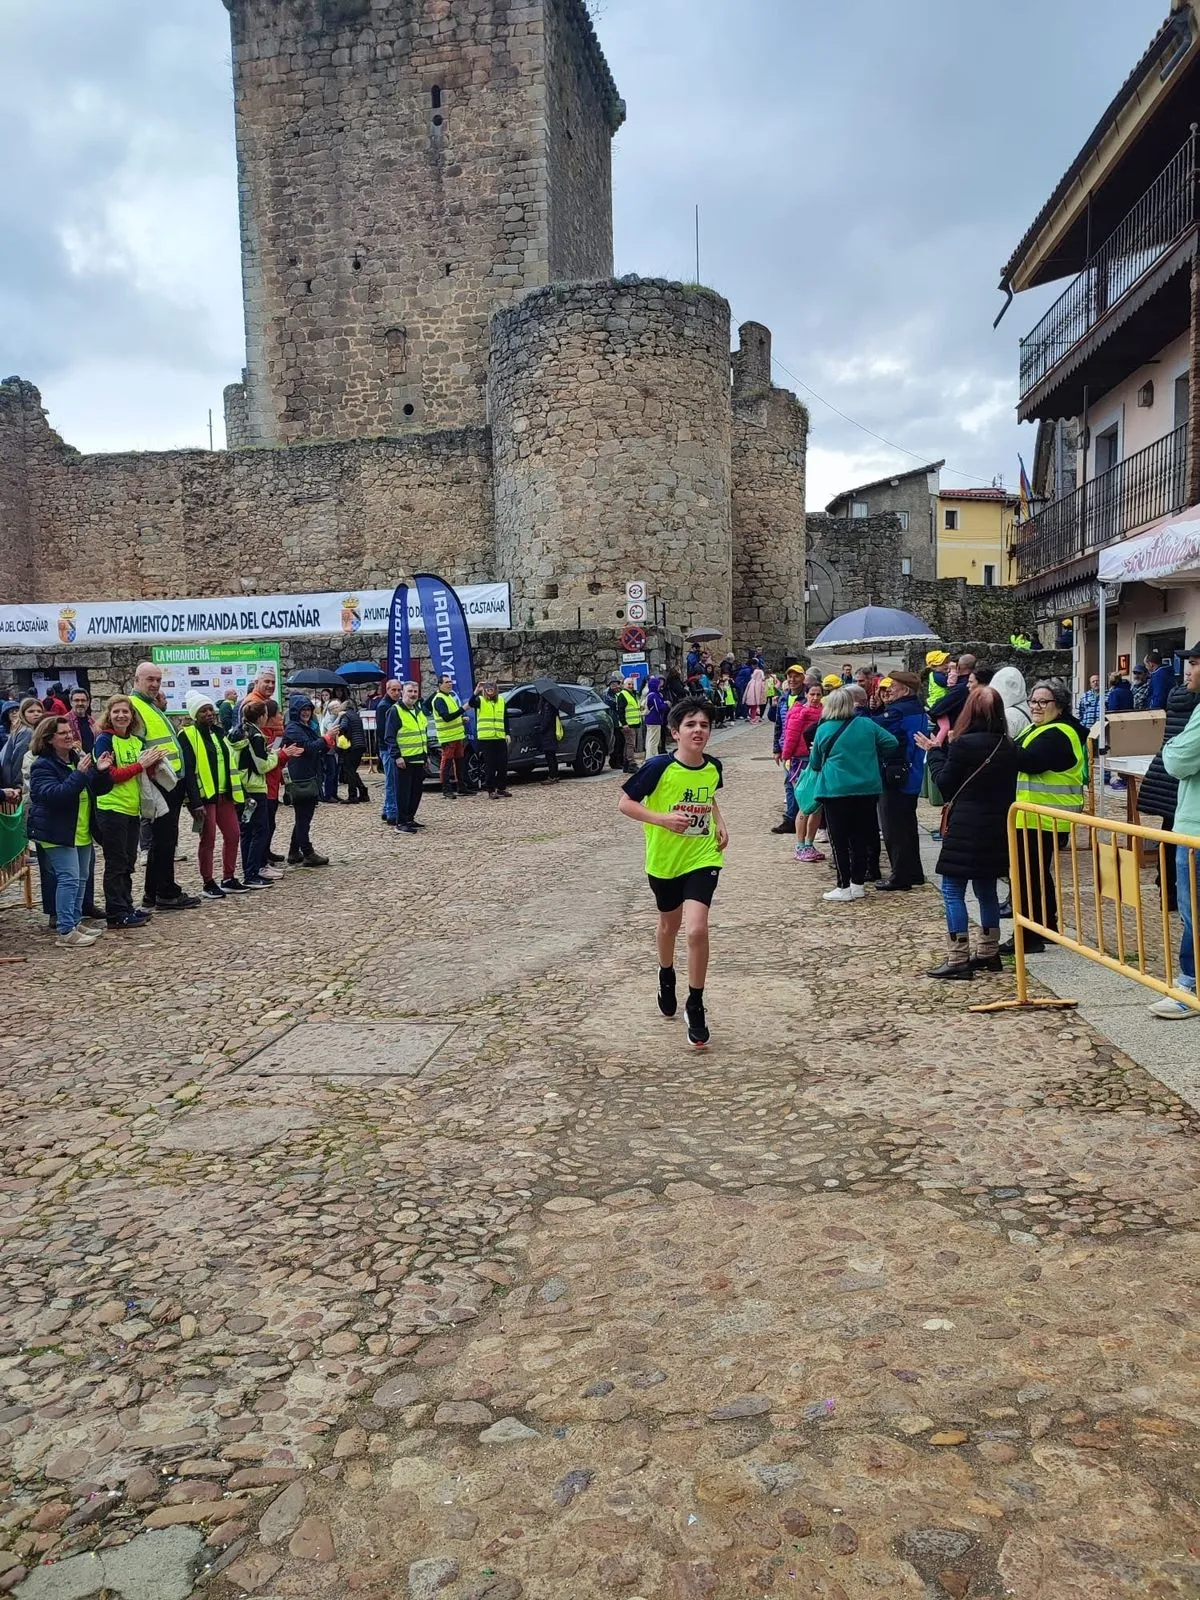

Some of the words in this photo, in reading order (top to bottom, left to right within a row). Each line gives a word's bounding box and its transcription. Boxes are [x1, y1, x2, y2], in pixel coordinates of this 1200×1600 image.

[470, 597, 505, 614] CASTAÑAR
[5, 621, 16, 633] DEL
[16, 617, 49, 632] CASTAÑAR
[87, 615, 169, 634] AYUNTAMIENTO
[171, 614, 185, 632] DE
[187, 613, 238, 631] MIRANDA
[240, 611, 259, 630] DEL
[261, 604, 321, 629] CASTAÑAR
[155, 649, 165, 662] LA
[166, 646, 210, 661] MIRANDEÑA
